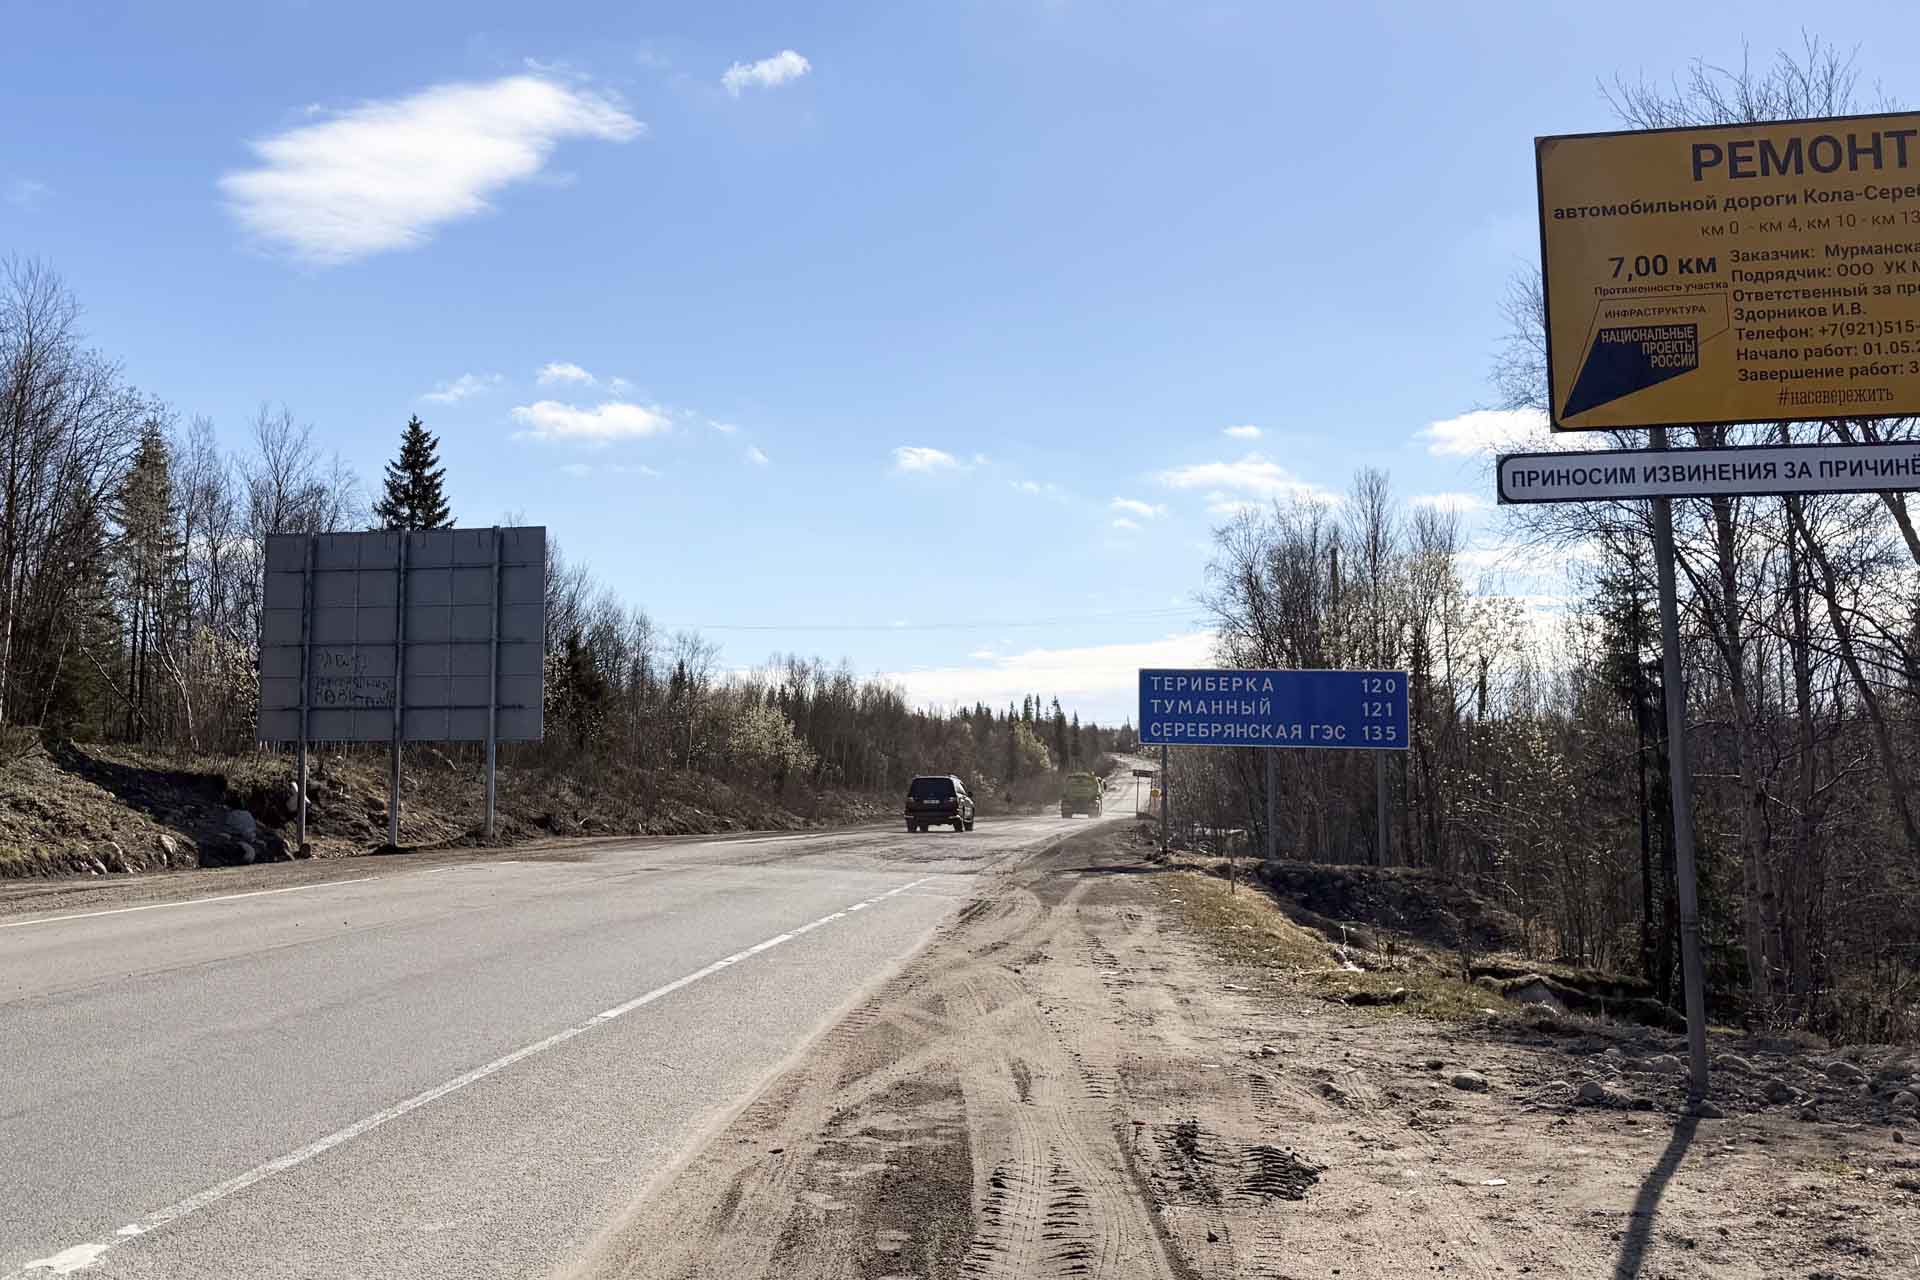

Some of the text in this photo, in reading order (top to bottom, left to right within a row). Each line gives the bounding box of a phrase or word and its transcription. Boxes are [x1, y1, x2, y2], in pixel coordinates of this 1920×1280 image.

[1692, 129, 1918, 183] РЕМОНТ
[1554, 195, 1717, 220] автомобильной
[1723, 193, 1797, 212] дороги
[1759, 221, 1783, 233] км
[1787, 217, 1803, 231] 4,
[1807, 217, 1831, 229] км
[1837, 213, 1856, 227] 10
[1871, 214, 1896, 225] км
[1729, 248, 1815, 263] Заказчик:
[1608, 254, 1717, 282] 7,00 км
[1731, 266, 1832, 284] Подрядчик:
[1836, 262, 1874, 277] ООО
[1883, 260, 1907, 274] УК
[1594, 280, 1729, 297] Протяженность участка
[1732, 282, 1868, 303] Ответственный
[1872, 284, 1892, 296] за
[1604, 304, 1706, 319] ИНФРАСТРУКТУРА
[1734, 302, 1868, 323] Здорников И.В.
[1601, 326, 1696, 344] НАЦИОНАЛЬНЫЕ
[1735, 325, 1815, 342] Телефон:
[1642, 340, 1696, 356] ПРОЕКТЫ
[1736, 346, 1799, 361] Начало
[1804, 343, 1858, 360] работ:
[1651, 353, 1697, 369] РОССИИ
[1738, 366, 1844, 382] Завершение
[1850, 362, 1904, 379] работ:
[1511, 453, 1920, 488] ПРИНОСИМ ИЗВИНЕНИЯ ЗА ПРИЧИНЁ
[1150, 676, 1397, 694] ТЕРИБЕРКА 120
[1151, 698, 1394, 717] ТУМАННЫЙ 121
[1150, 722, 1397, 741] СЕРЕБРЯНСКАЯ ГЭС 135
